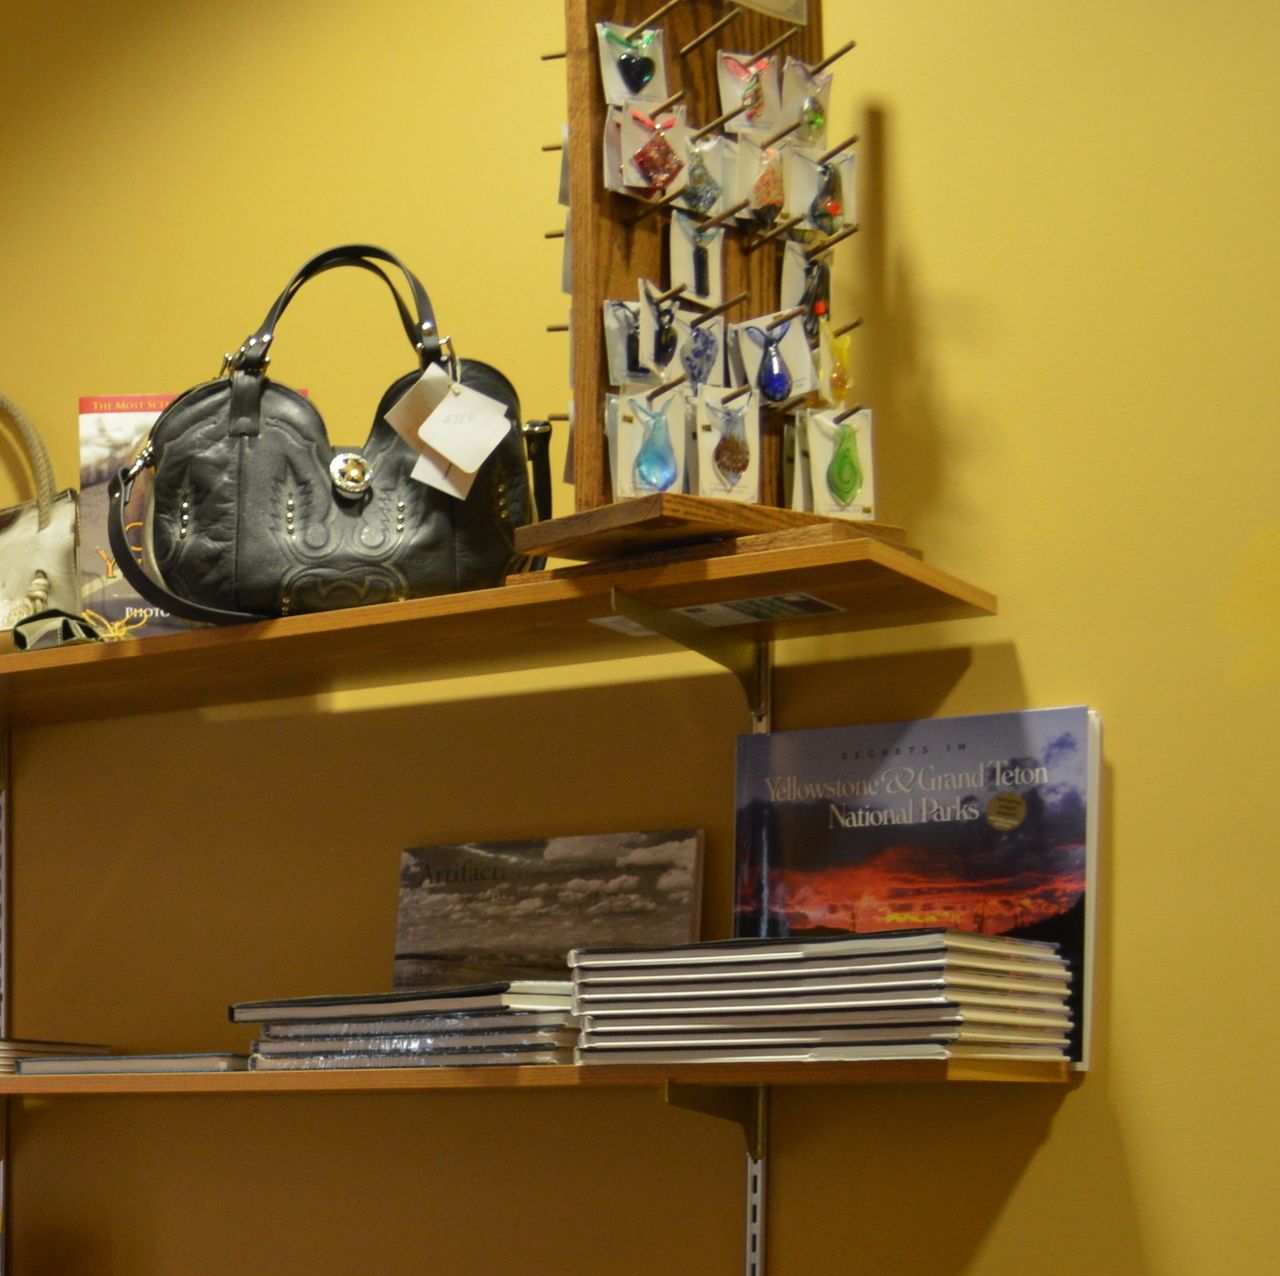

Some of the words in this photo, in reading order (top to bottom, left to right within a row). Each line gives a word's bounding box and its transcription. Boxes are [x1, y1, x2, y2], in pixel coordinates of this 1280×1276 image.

[765, 773, 881, 803] Yellowstone
[881, 765, 917, 795] &
[918, 760, 986, 793] Grand
[989, 758, 1050, 788] Teton
[827, 802, 915, 830] National
[919, 796, 981, 825] Parks
